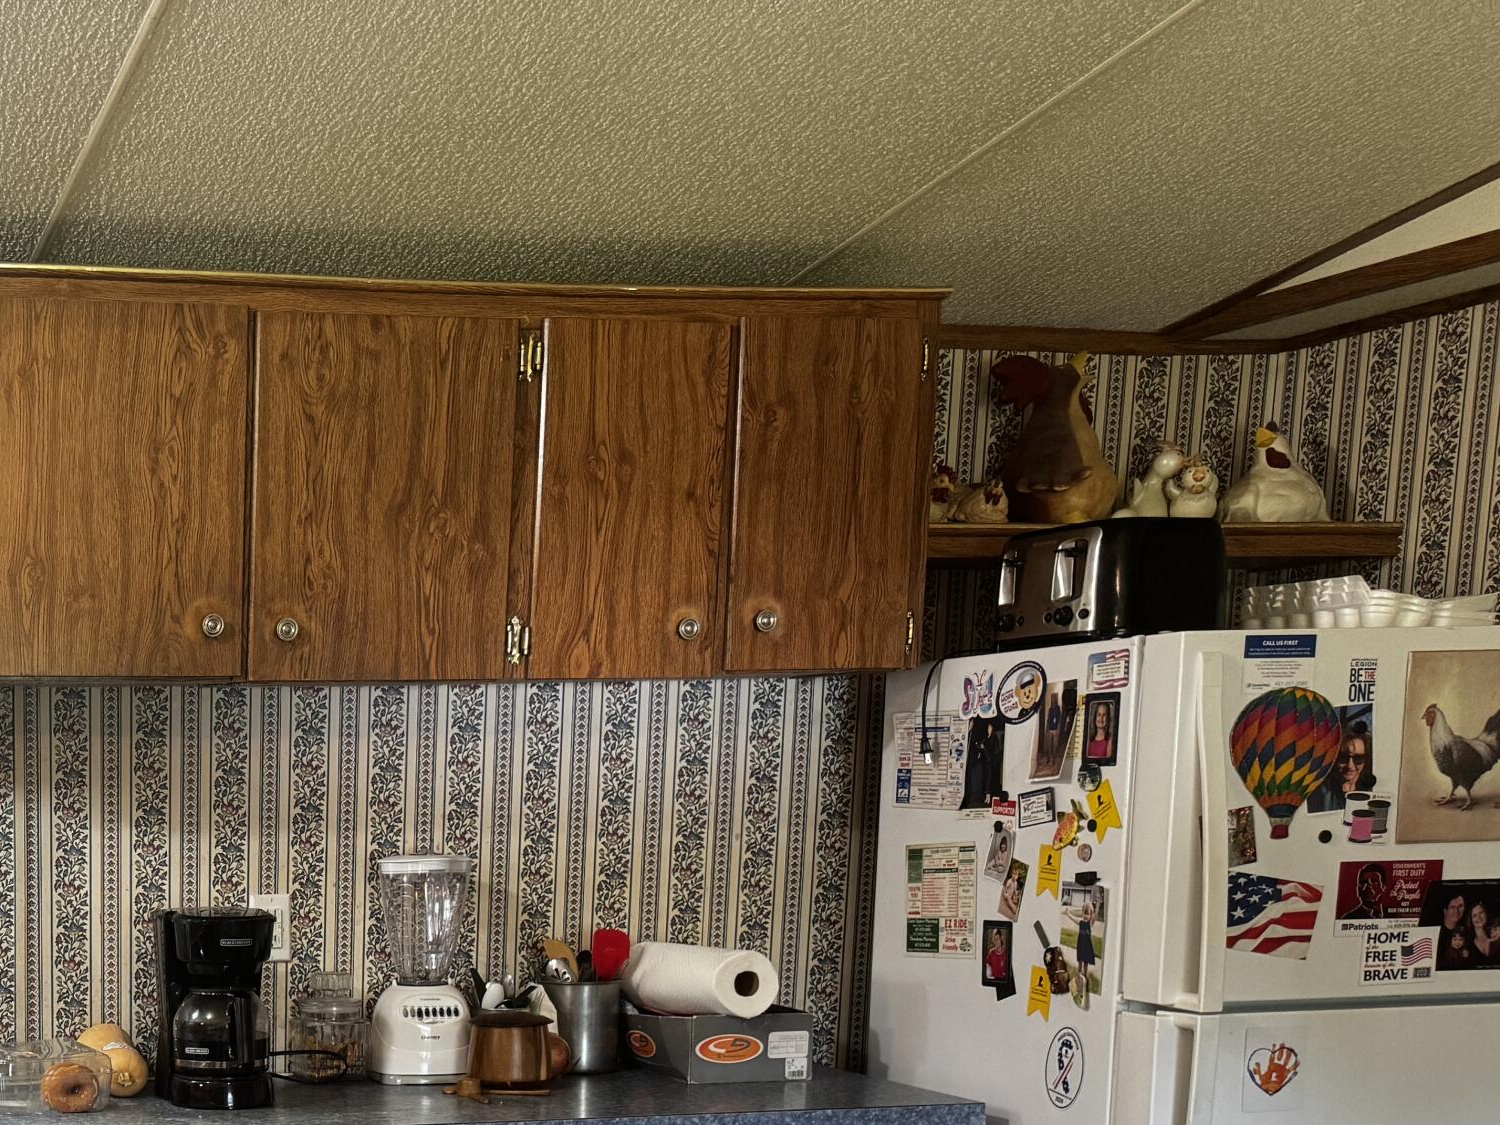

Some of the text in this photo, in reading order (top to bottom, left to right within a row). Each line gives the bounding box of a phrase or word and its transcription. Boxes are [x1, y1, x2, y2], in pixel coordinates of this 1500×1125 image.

[1350, 668, 1376, 683] BE THE
[1348, 684, 1375, 702] ONE
[1410, 869, 1426, 877] DUTY
[1394, 879, 1419, 890] Protect
[1397, 889, 1421, 901] People
[944, 919, 968, 928] EZ RIDE
[1348, 923, 1379, 931] Patriots
[1366, 931, 1410, 945] HOME
[1365, 950, 1397, 963] FREE
[1364, 968, 1408, 982] BRAVE
